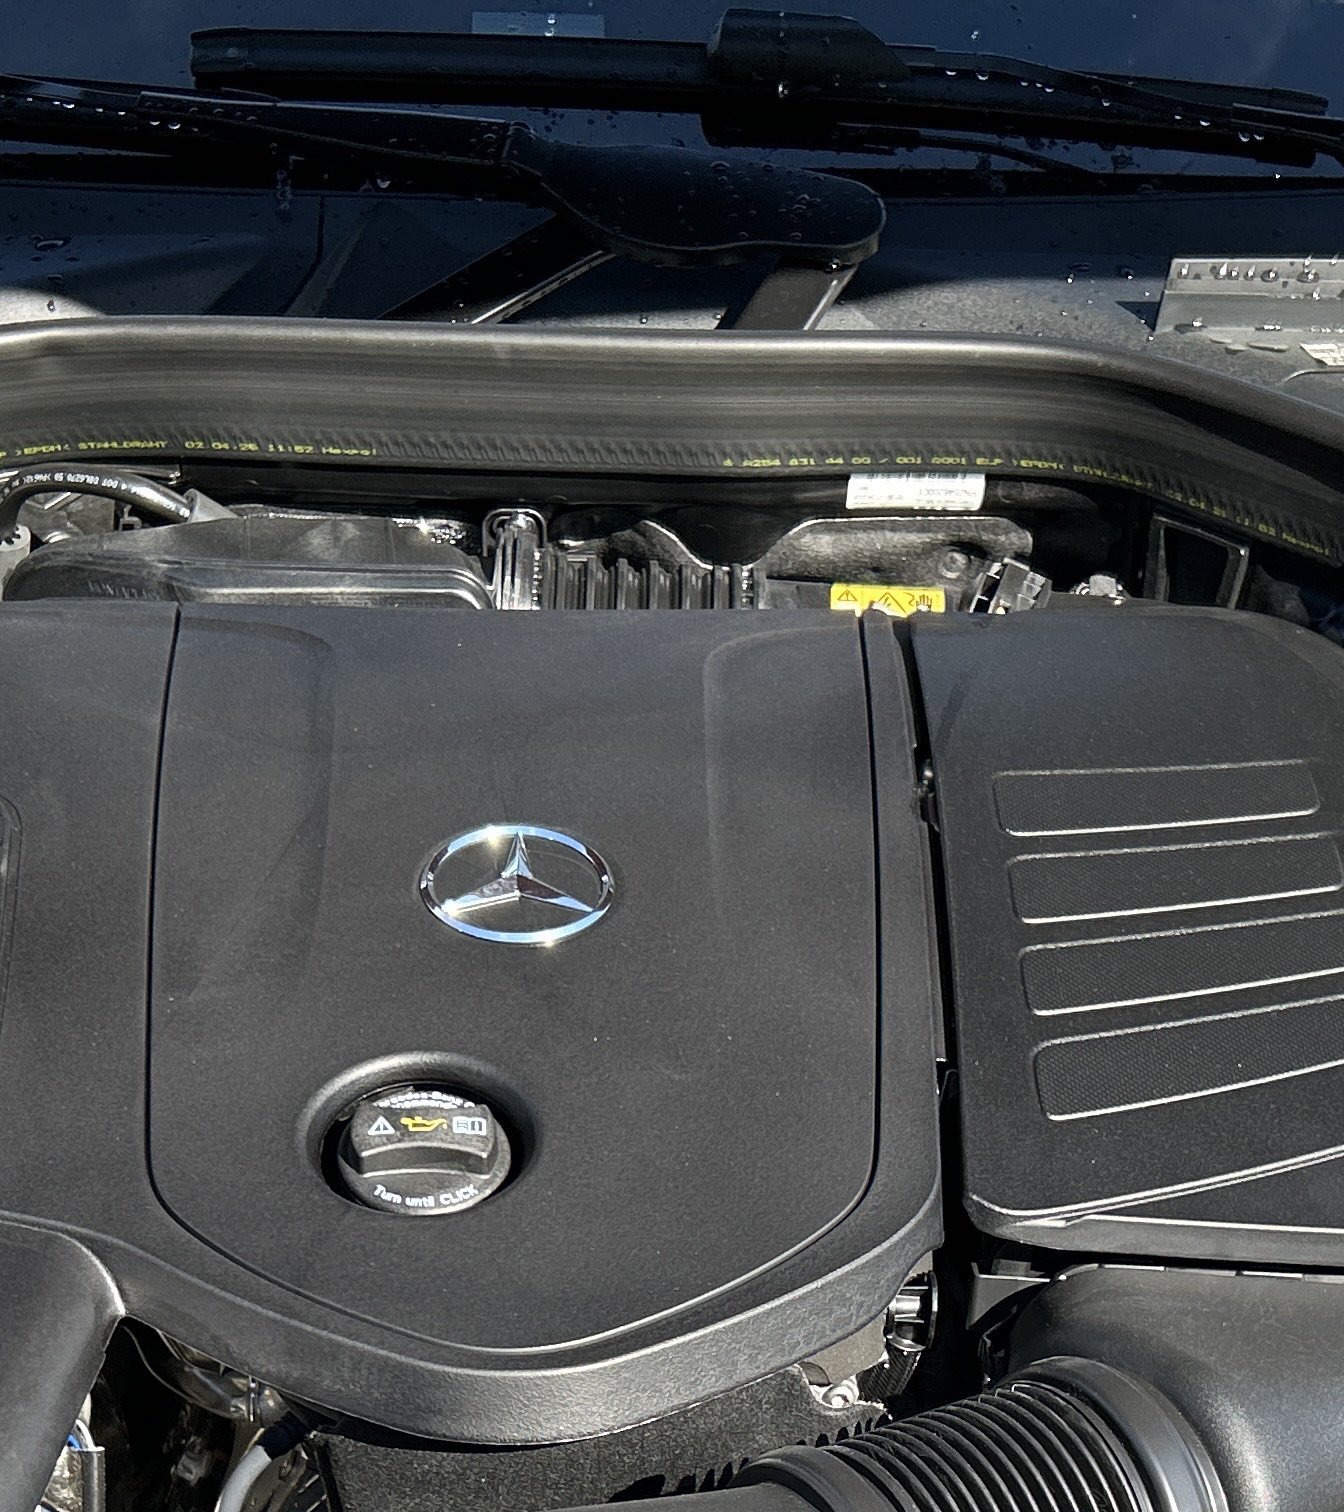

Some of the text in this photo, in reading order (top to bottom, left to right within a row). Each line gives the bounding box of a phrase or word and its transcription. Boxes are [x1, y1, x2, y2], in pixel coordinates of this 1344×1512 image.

[851, 456, 872, 465] 00
[372, 1184, 479, 1208] Turn until CLICK
